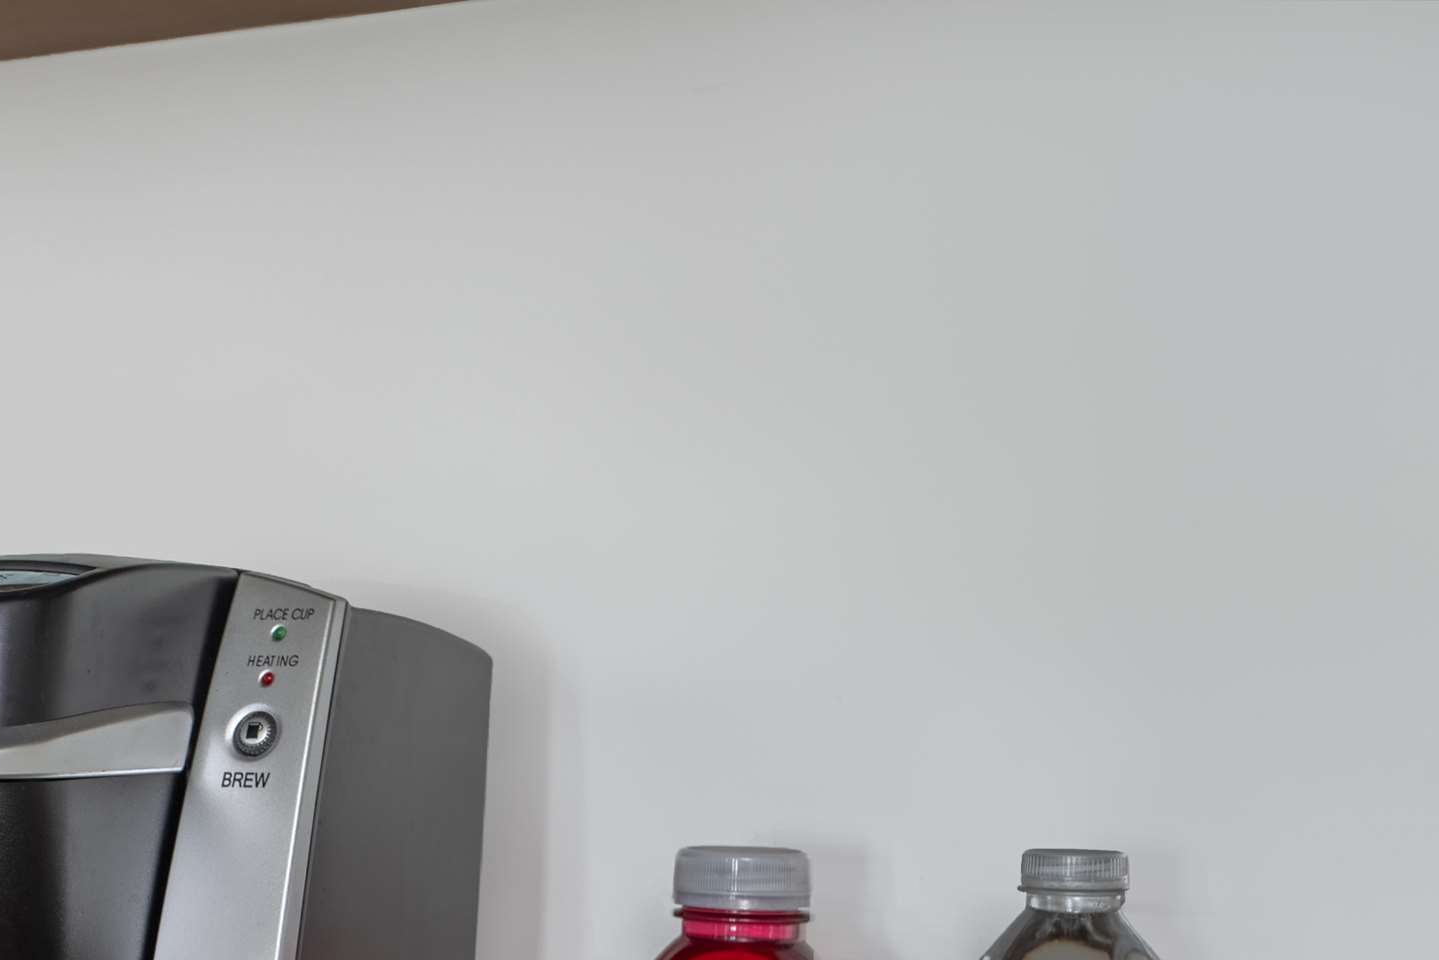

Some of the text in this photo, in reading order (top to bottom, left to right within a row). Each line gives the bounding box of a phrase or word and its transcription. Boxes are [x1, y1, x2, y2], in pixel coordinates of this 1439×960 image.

[253, 608, 316, 621] PLACE CUP
[246, 655, 300, 667] HEATING
[221, 771, 271, 788] BREW
